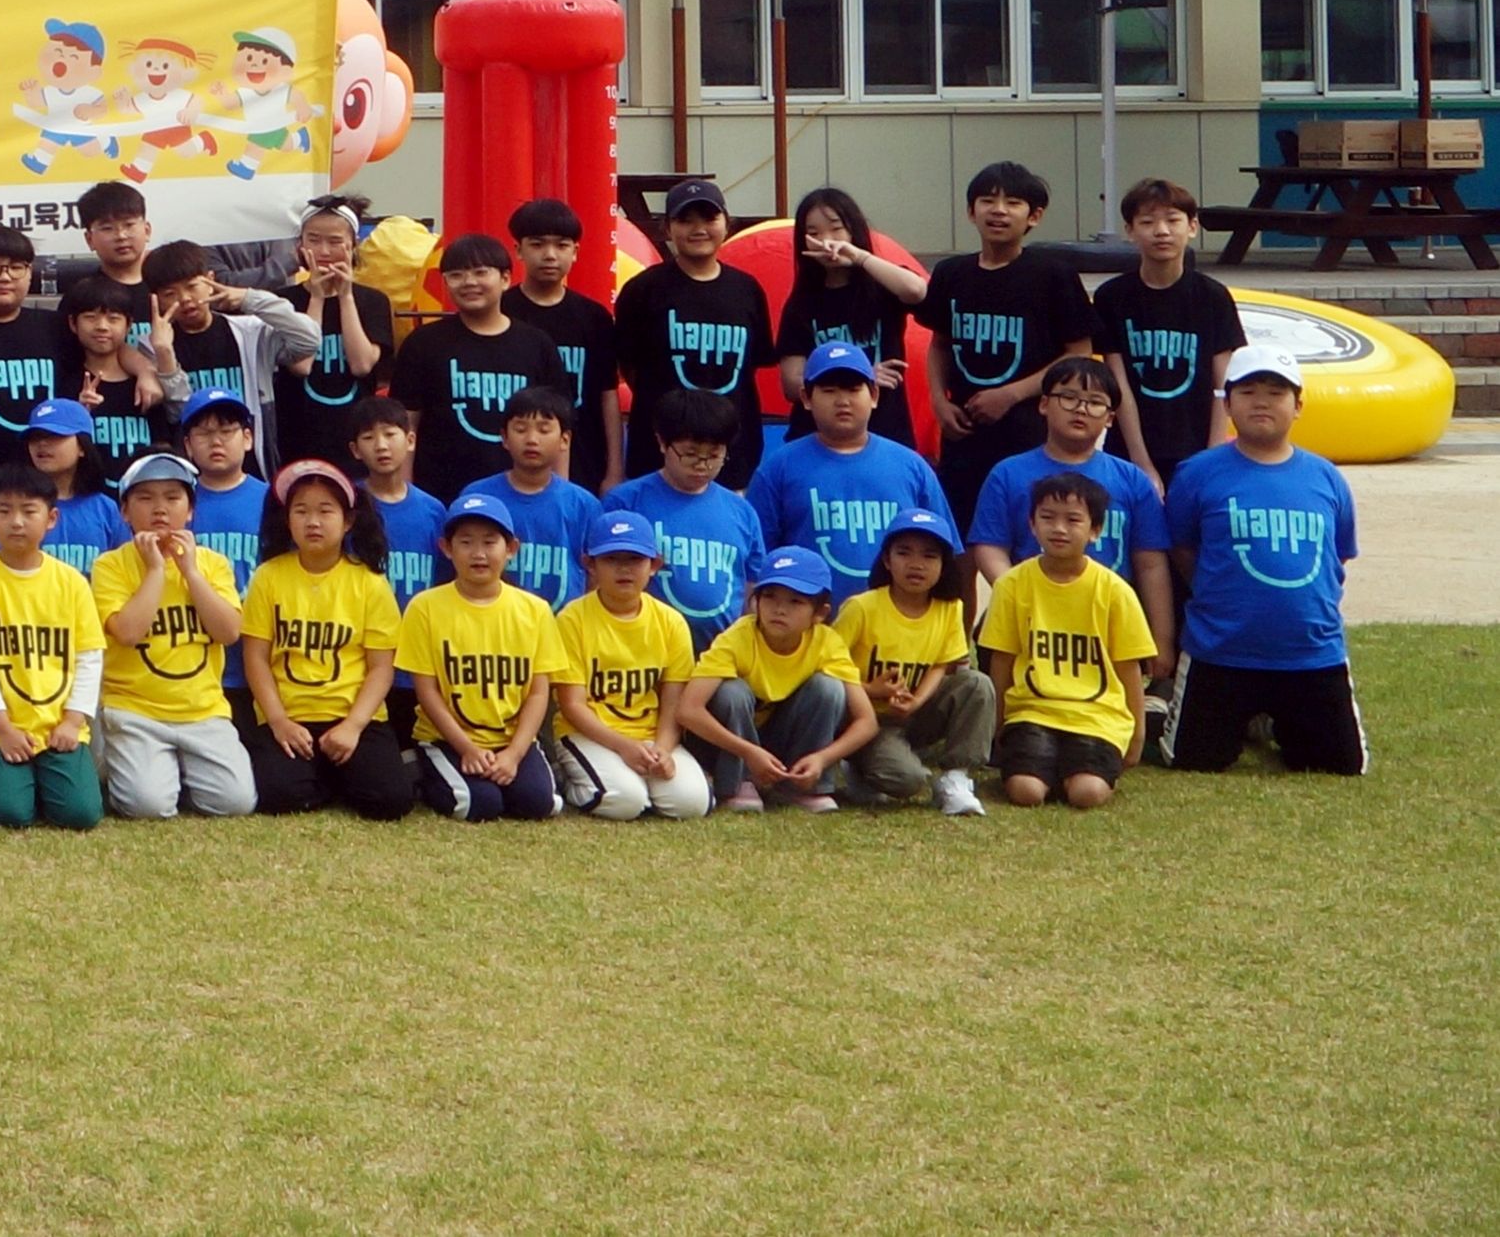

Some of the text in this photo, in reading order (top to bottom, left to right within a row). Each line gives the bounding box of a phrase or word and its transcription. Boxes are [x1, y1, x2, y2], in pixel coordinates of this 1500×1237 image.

[668, 308, 748, 364] happy
[951, 299, 1025, 354] happy
[1126, 319, 1198, 369] happy
[189, 366, 244, 399] appy
[93, 416, 152, 457] appy
[1228, 496, 1324, 552] happy
[196, 532, 259, 571] ppy
[390, 551, 432, 594] ppy
[507, 542, 568, 588] ppy
[655, 521, 738, 583] happy
[275, 605, 352, 664] happy
